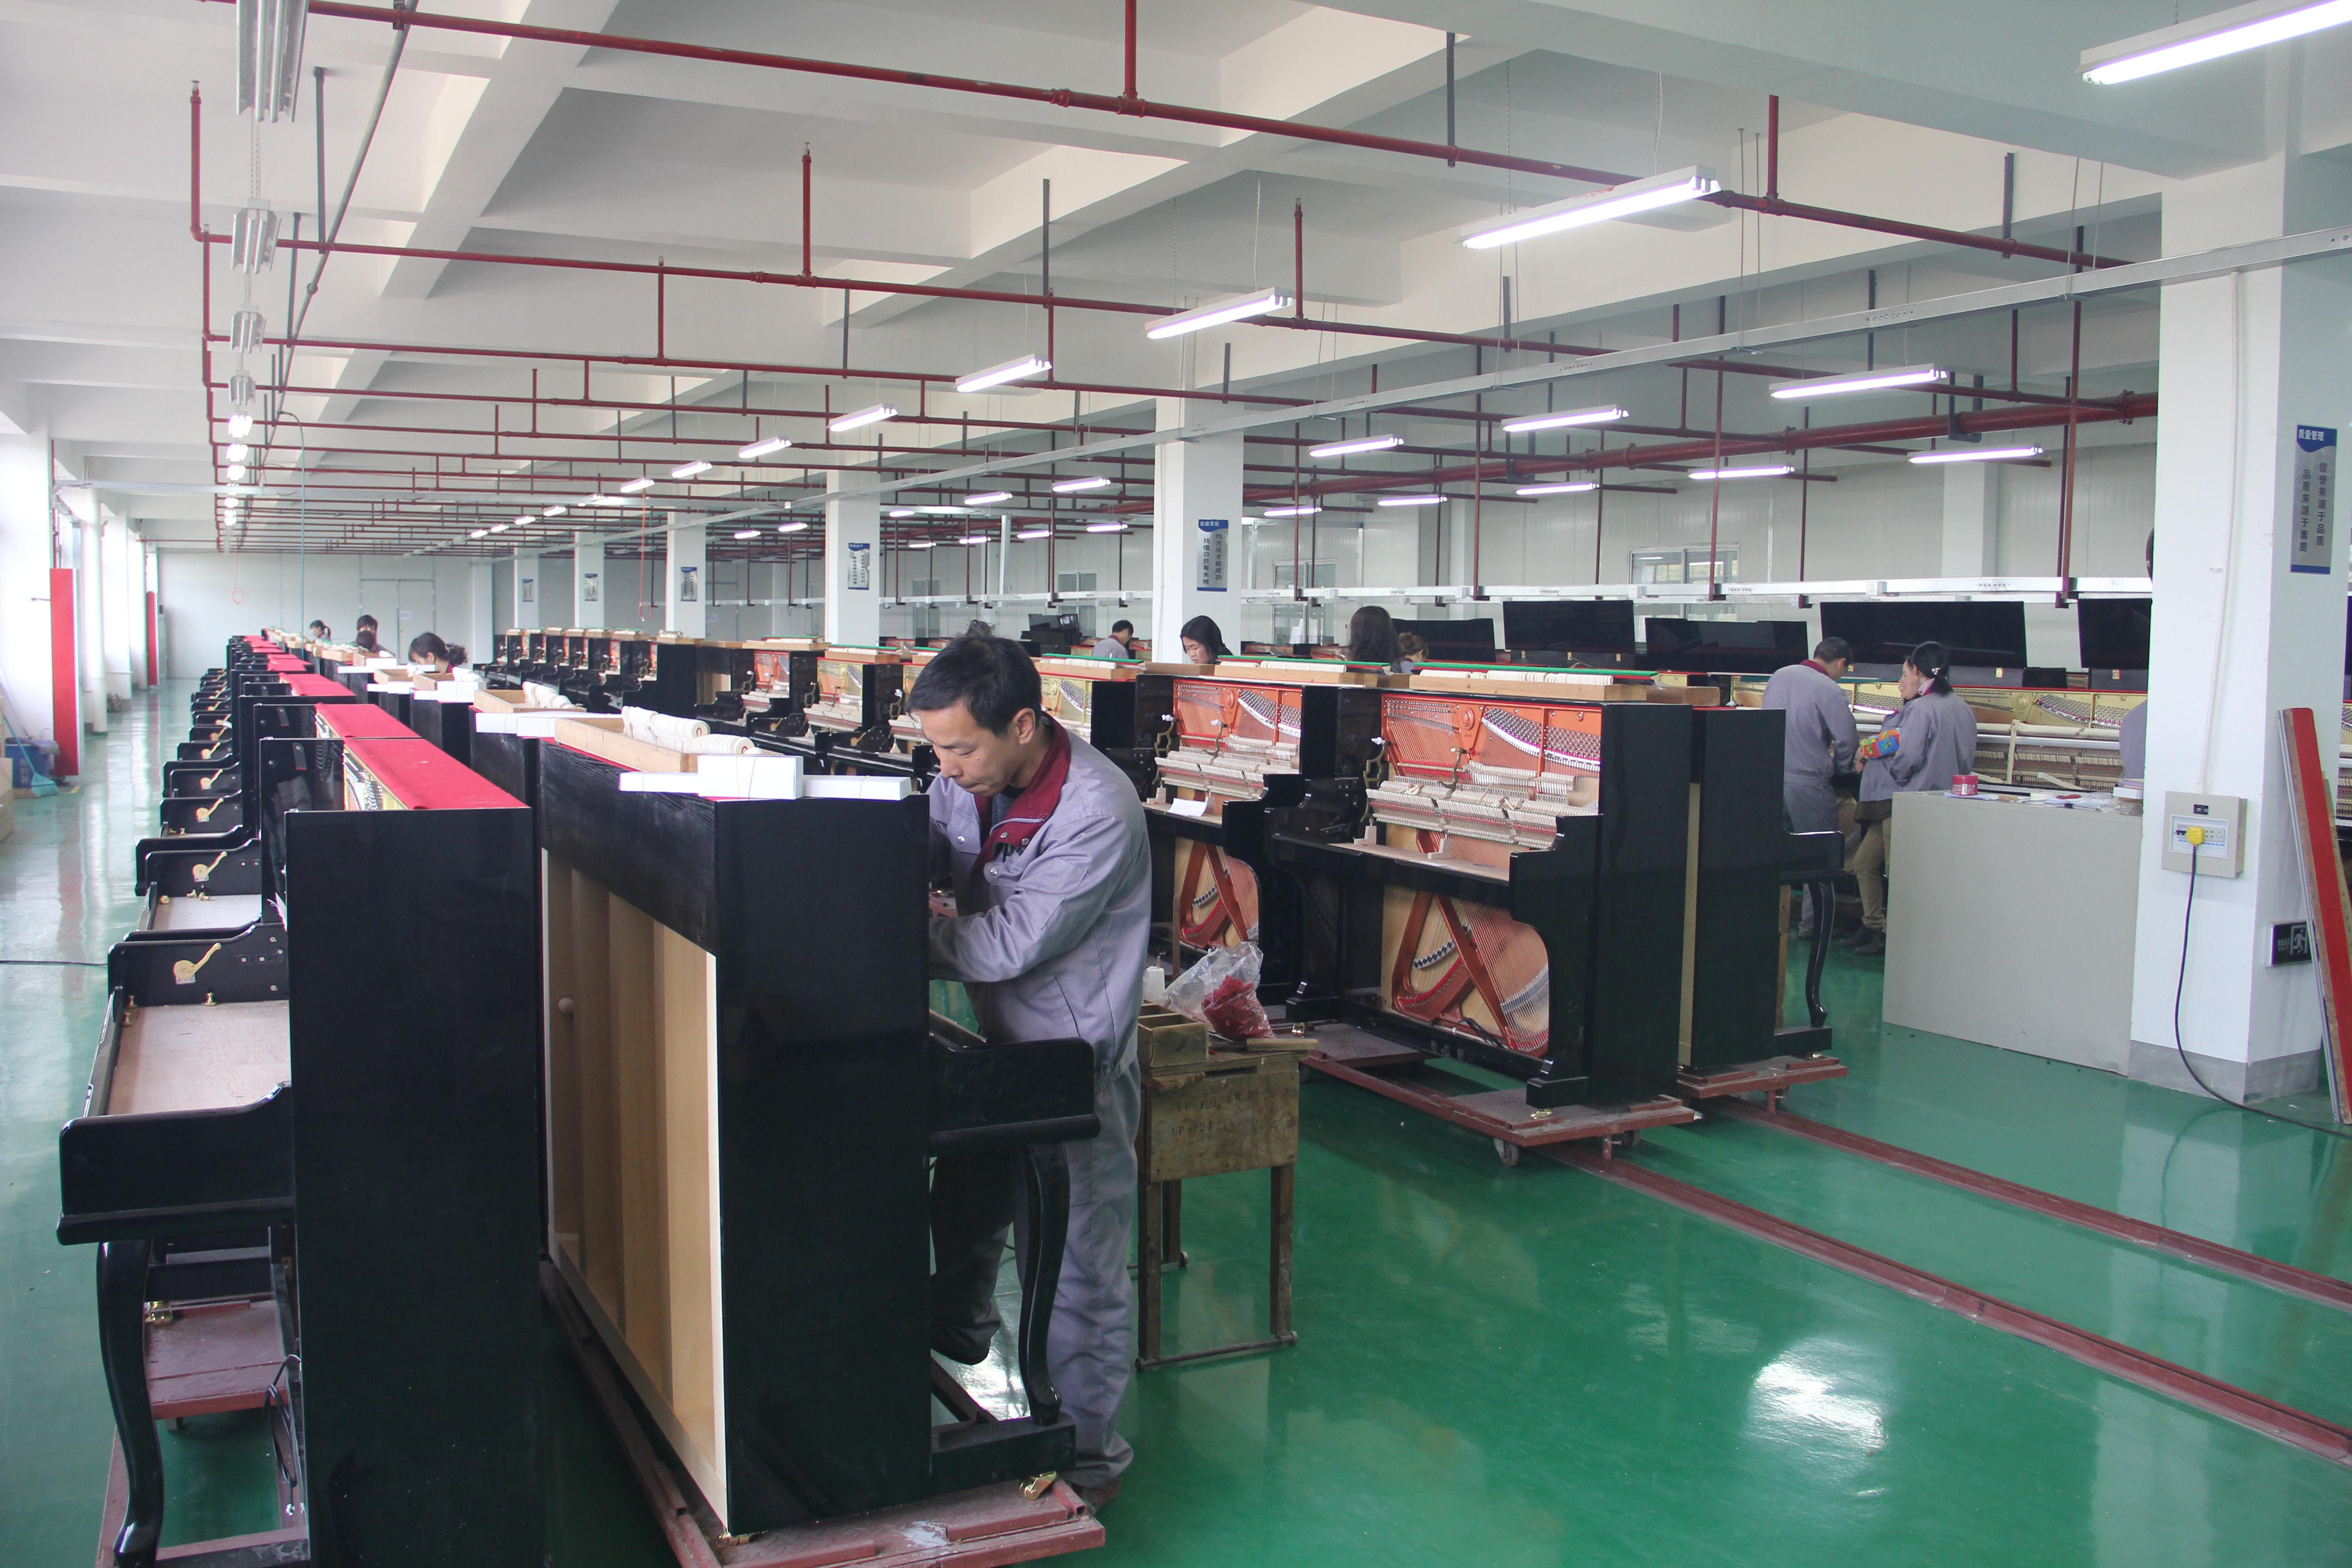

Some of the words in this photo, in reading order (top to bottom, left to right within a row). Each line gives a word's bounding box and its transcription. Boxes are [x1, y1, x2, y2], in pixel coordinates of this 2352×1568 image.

[2298, 429, 2324, 441] 质量管理
[2299, 469, 2311, 552] 品质来源于素质
[2316, 462, 2328, 546] 信誉来源于品质
[1235, 1092, 1241, 1100] W
[1247, 1089, 1257, 1099] 20
